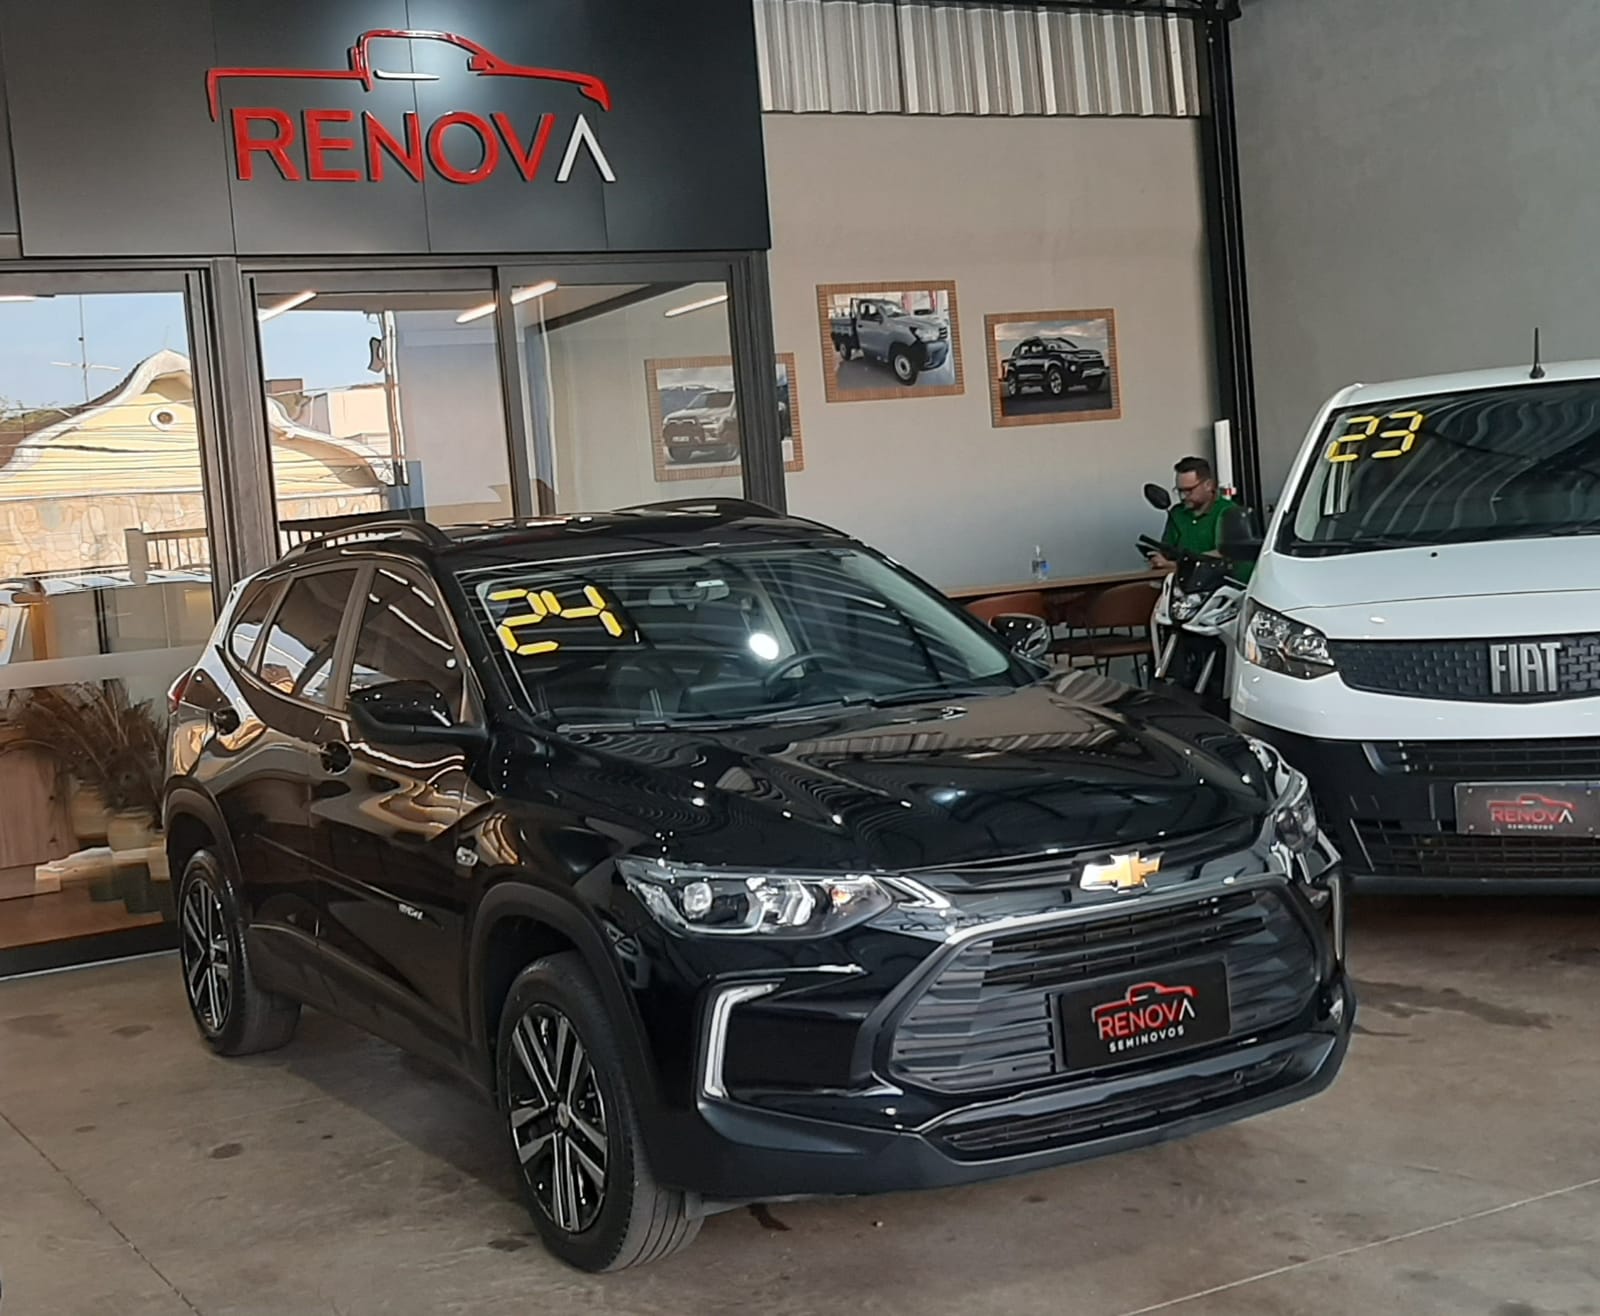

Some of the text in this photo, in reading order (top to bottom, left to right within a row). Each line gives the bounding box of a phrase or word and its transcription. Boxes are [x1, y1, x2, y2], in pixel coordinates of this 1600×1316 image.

[231, 107, 616, 184] RENOVA
[1324, 411, 1423, 462] 23
[487, 584, 623, 656] 24
[1490, 642, 1561, 694] FIAT
[1491, 808, 1573, 824] RENOVA
[1098, 998, 1195, 1040] RENOVA
[1109, 1024, 1185, 1053] SEMINOVOS
